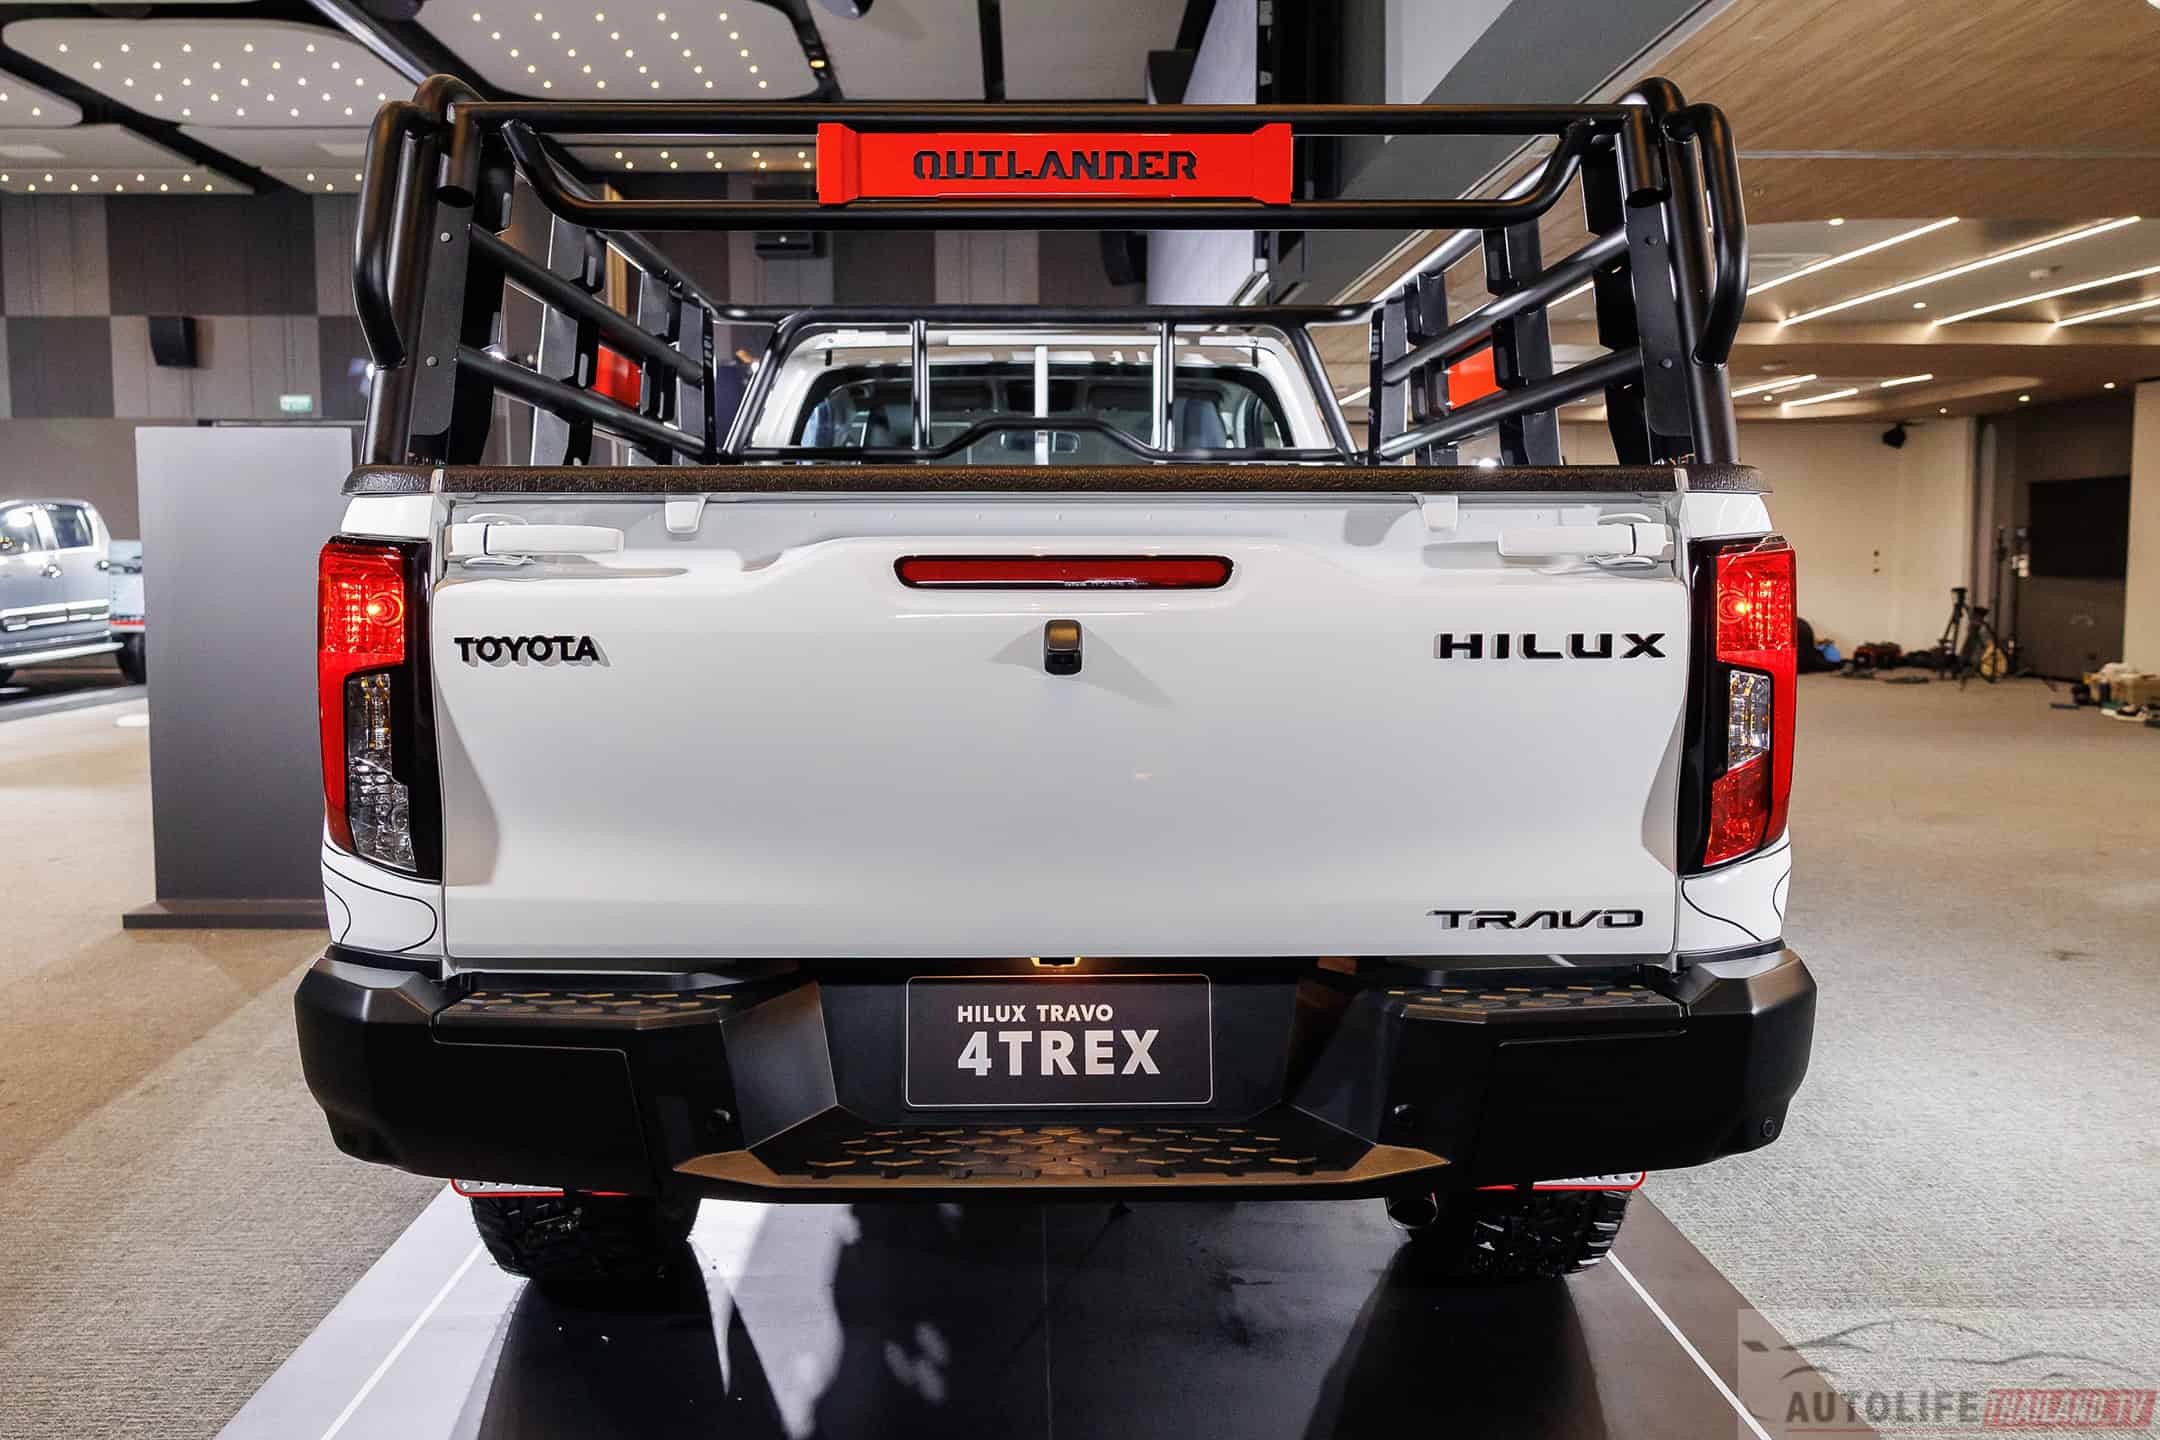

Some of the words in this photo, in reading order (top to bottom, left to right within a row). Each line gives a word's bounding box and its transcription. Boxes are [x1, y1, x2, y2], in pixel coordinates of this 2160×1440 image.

[913, 150, 1198, 180] OUTLANDER
[453, 635, 601, 663] TOYOTA
[1437, 632, 1667, 660] HILUX
[1430, 909, 1644, 929] TRAVO
[957, 1005, 1027, 1023] HILUX
[1036, 1004, 1114, 1023] TRAVO
[957, 1029, 1161, 1077] 4TREX
